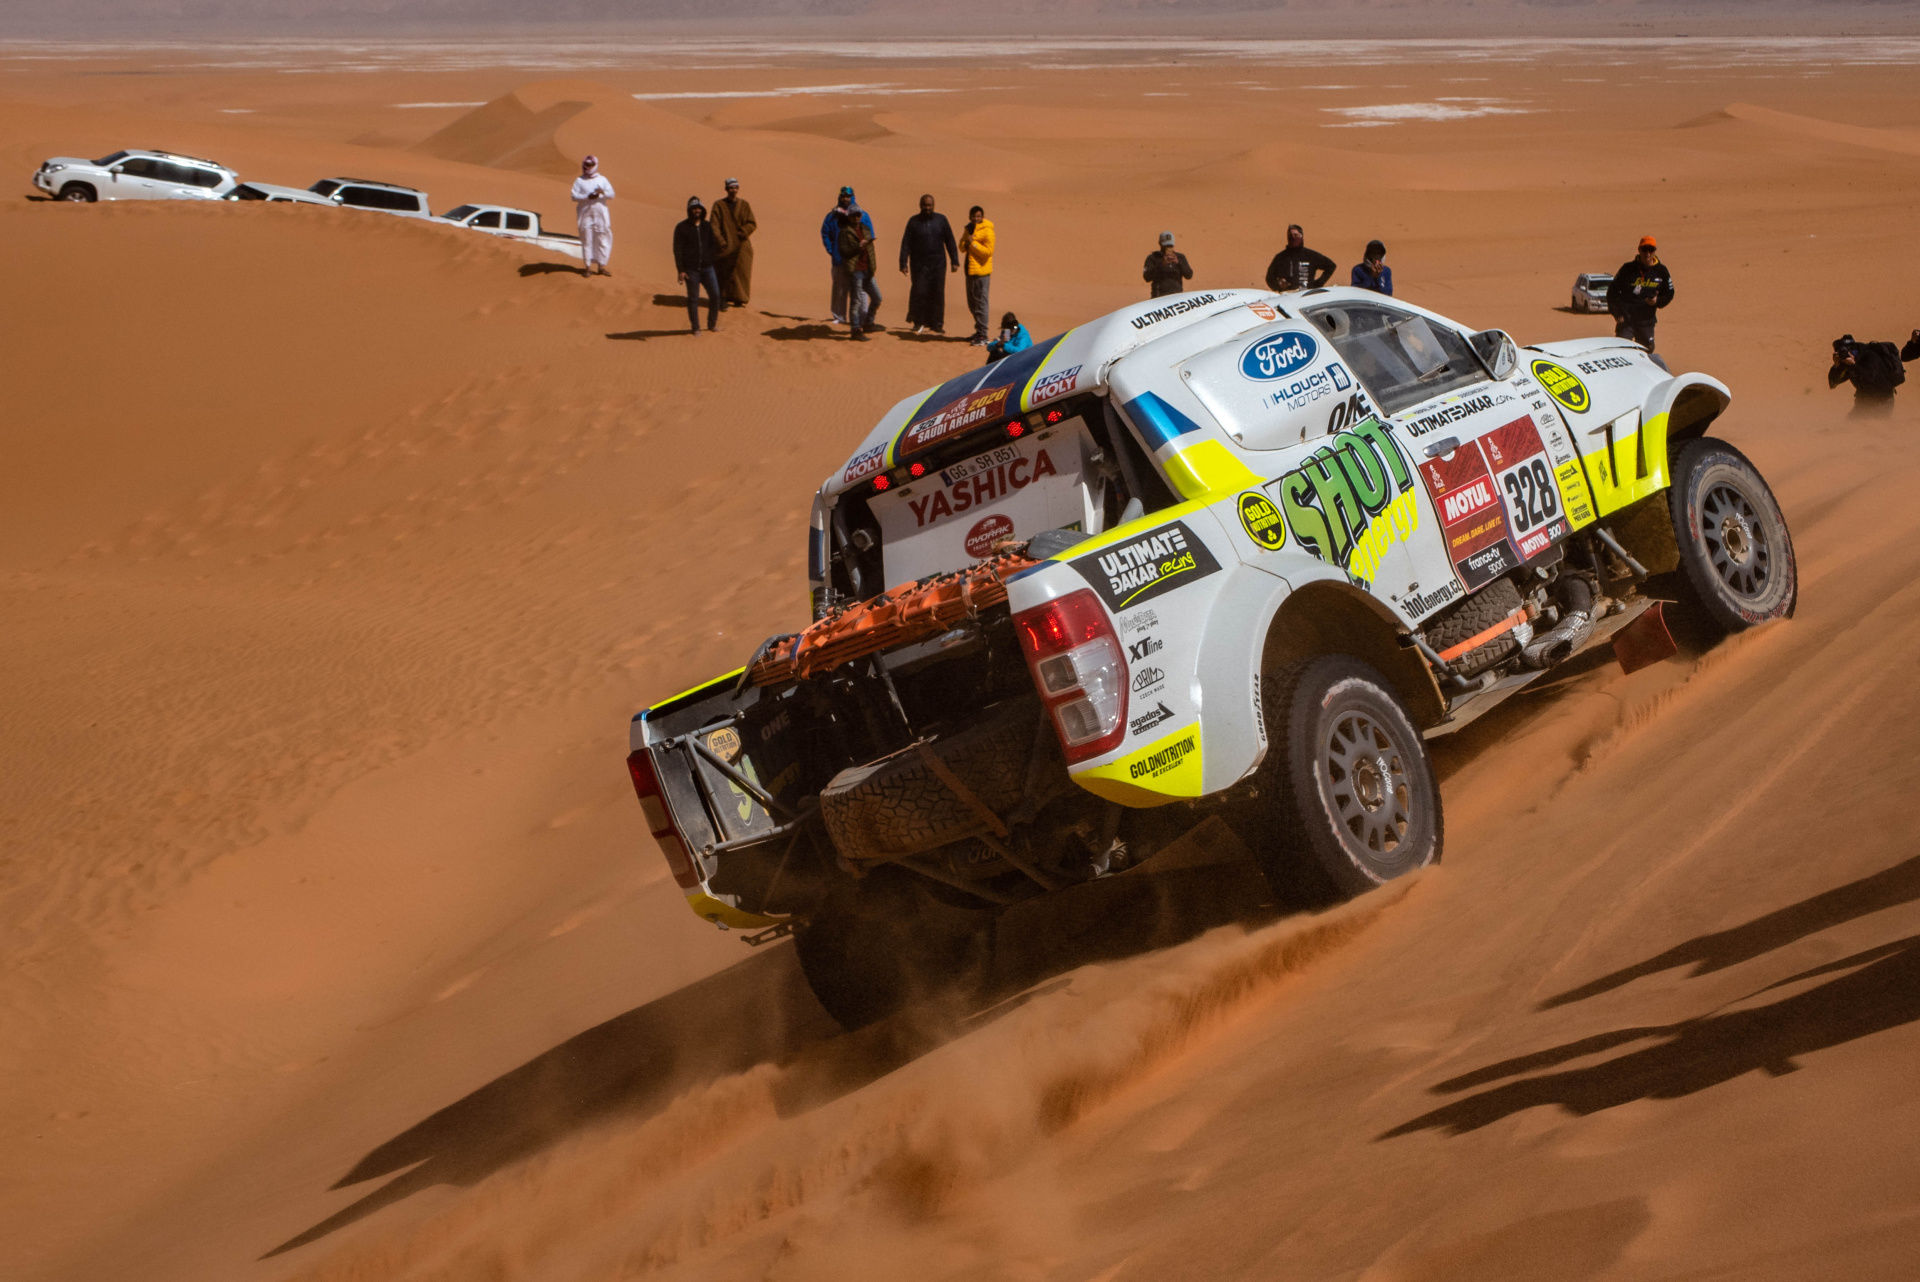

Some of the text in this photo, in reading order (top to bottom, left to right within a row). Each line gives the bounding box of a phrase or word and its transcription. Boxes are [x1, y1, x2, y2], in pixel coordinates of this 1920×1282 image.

[1255, 336, 1308, 376] Ford
[1577, 361, 1598, 375] BE
[1036, 365, 1082, 389] LIQUI
[1274, 371, 1328, 404] HLOUCH
[1540, 367, 1571, 386] GOLD
[967, 389, 1007, 413] 2020
[1033, 378, 1077, 405] MOLY
[1288, 384, 1332, 412] MOTORS
[917, 407, 987, 444] SAUDI ARABIA
[850, 442, 888, 468] LIQUI
[949, 464, 968, 481] GG
[975, 454, 995, 471] SR
[845, 456, 883, 482] MOLY
[909, 449, 1057, 527] YASHICA
[1280, 413, 1415, 580] SHOT
[1444, 481, 1492, 521] MOTUL
[1503, 458, 1557, 533] 328
[1244, 501, 1272, 521] GOLD
[1349, 486, 1419, 585] energy
[1521, 533, 1549, 555] MOTUL
[1548, 521, 1567, 542] 300V
[1098, 527, 1188, 578] ULTIMATE
[1110, 564, 1159, 596] DAKAR
[1487, 557, 1508, 577] sport
[1128, 636, 1163, 665] XTline
[1135, 666, 1158, 688] PRIM
[1129, 707, 1162, 729] agados
[1253, 673, 1267, 743] GOODYEAR
[761, 710, 791, 741] ONE
[712, 732, 733, 747] GOLD
